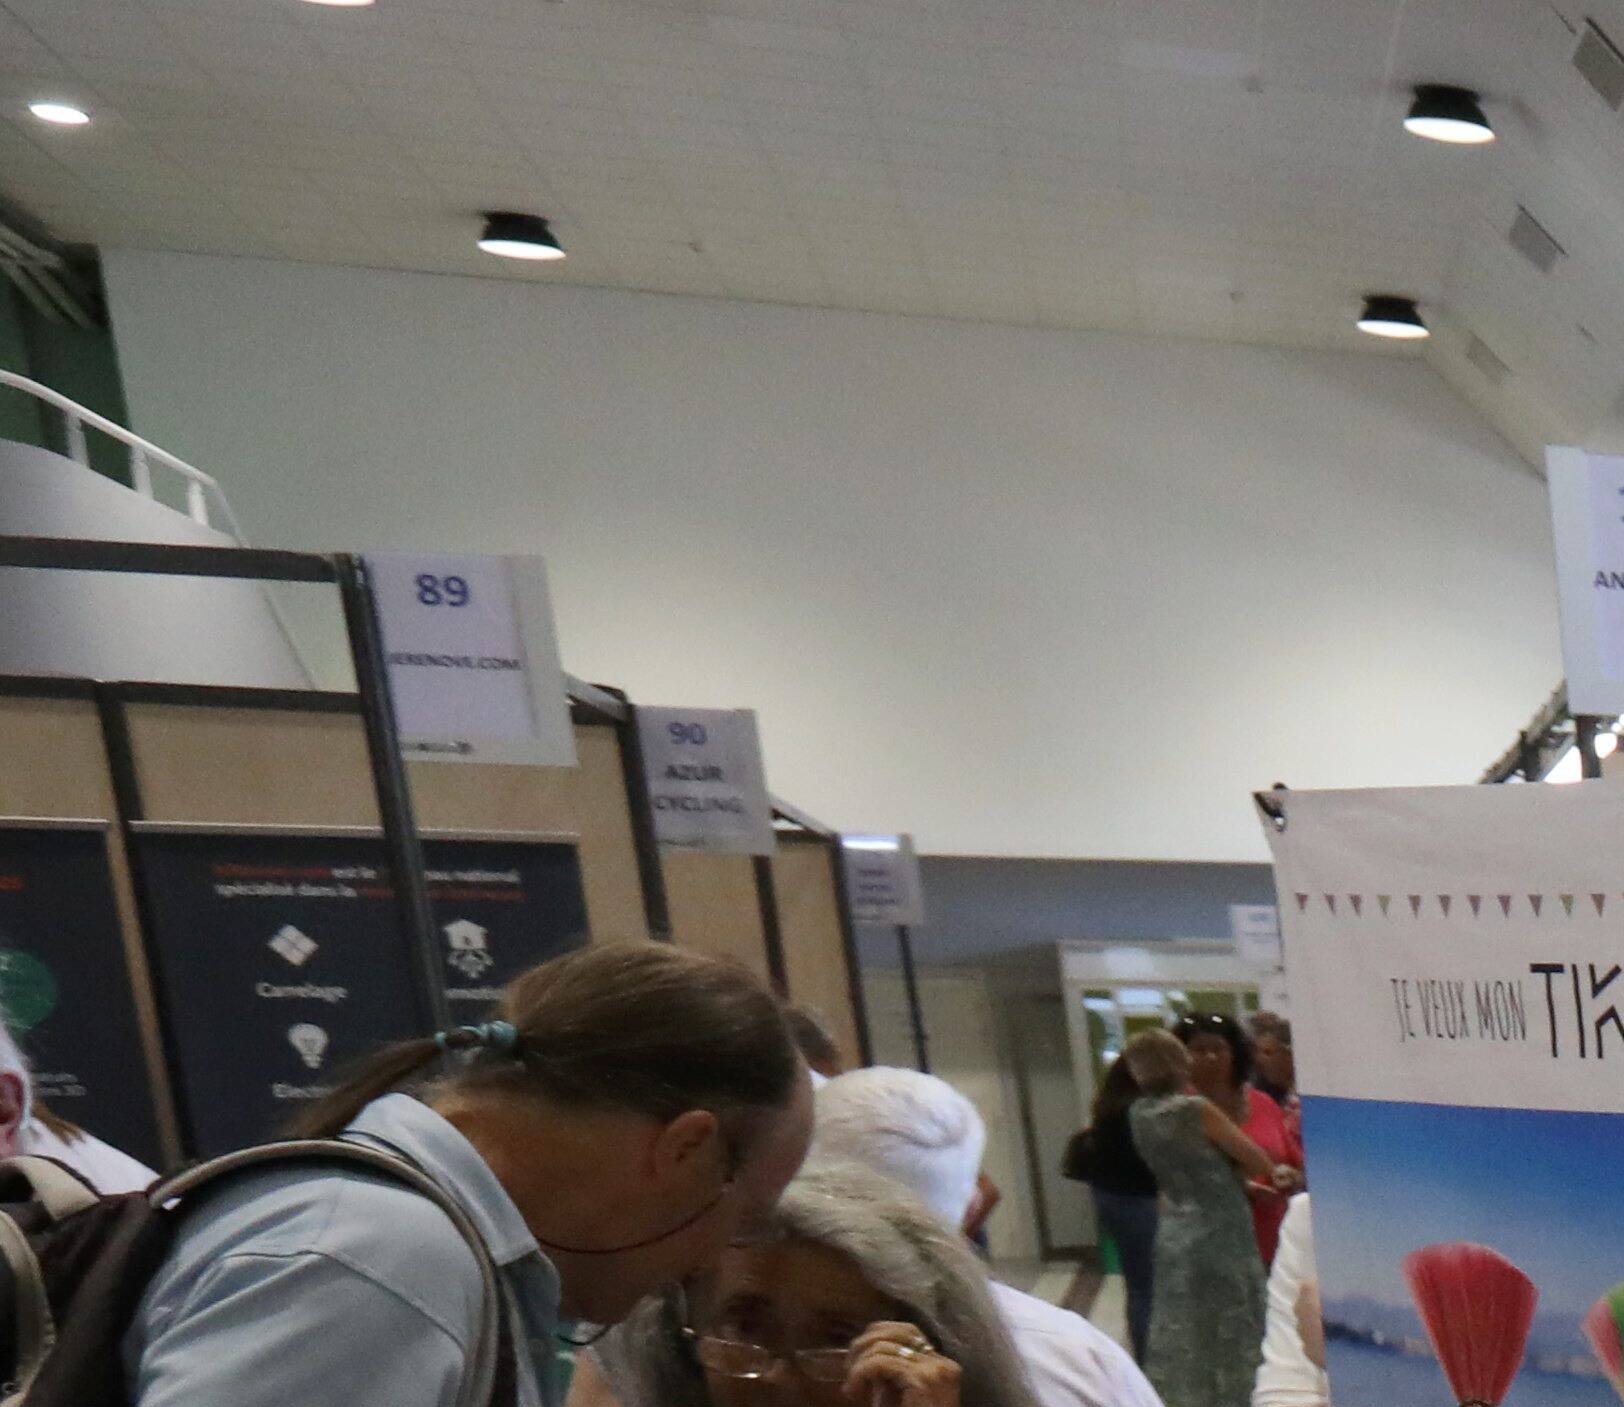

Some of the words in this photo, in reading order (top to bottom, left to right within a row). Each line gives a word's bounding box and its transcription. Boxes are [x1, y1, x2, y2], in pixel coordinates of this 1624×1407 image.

[415, 573, 469, 607] 89
[667, 721, 708, 745] 90
[1415, 980, 1470, 1040] VEUX
[1475, 980, 1527, 1041] MON
